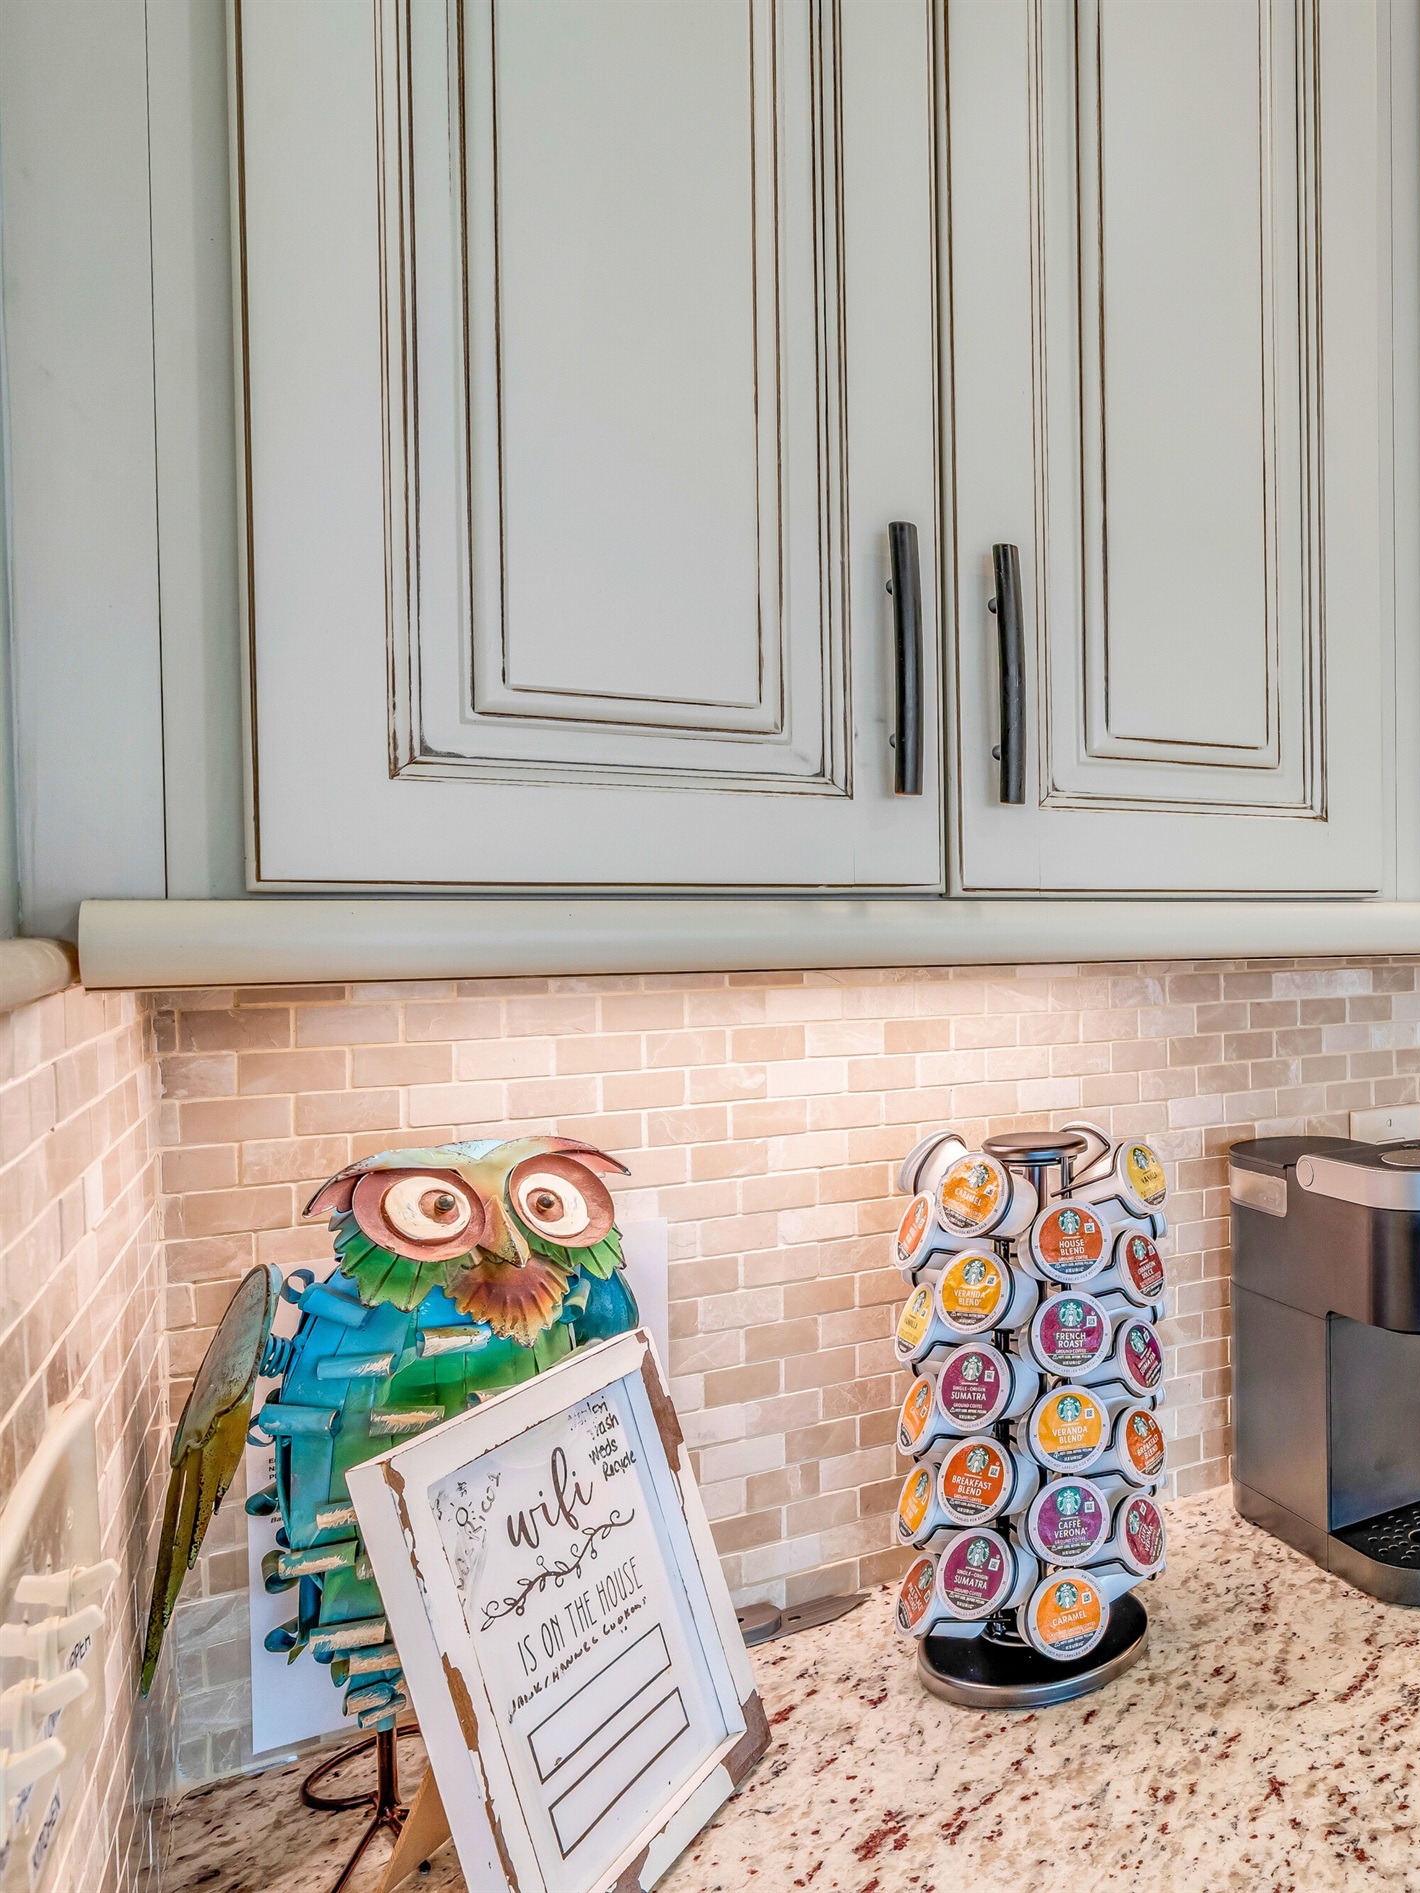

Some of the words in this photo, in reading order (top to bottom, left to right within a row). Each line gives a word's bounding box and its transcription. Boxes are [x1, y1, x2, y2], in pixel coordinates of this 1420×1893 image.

[1141, 1172, 1158, 1184] VANILLA
[954, 1187, 982, 1206] CARAMEL
[1060, 1239, 1085, 1248] HOUSE
[1060, 1247, 1085, 1256] BLEND
[954, 1289, 986, 1299] VERANDA
[1056, 1332, 1086, 1340] FRENCH
[1058, 1340, 1084, 1348] ROAST
[951, 1391, 987, 1400] SUMATRA
[1052, 1426, 1088, 1437] VERANDA
[602, 1450, 637, 1482] Recycle
[951, 1475, 992, 1490] BREAKFAST
[958, 1485, 982, 1496] BLEND
[507, 1446, 593, 1549] wifi
[953, 1575, 987, 1590] SUMATRA
[517, 1634, 538, 1676] IS
[541, 1614, 565, 1659] ON
[564, 1590, 597, 1638] THE
[596, 1556, 643, 1616] HOUSE
[1052, 1610, 1087, 1627] CARAMEL
